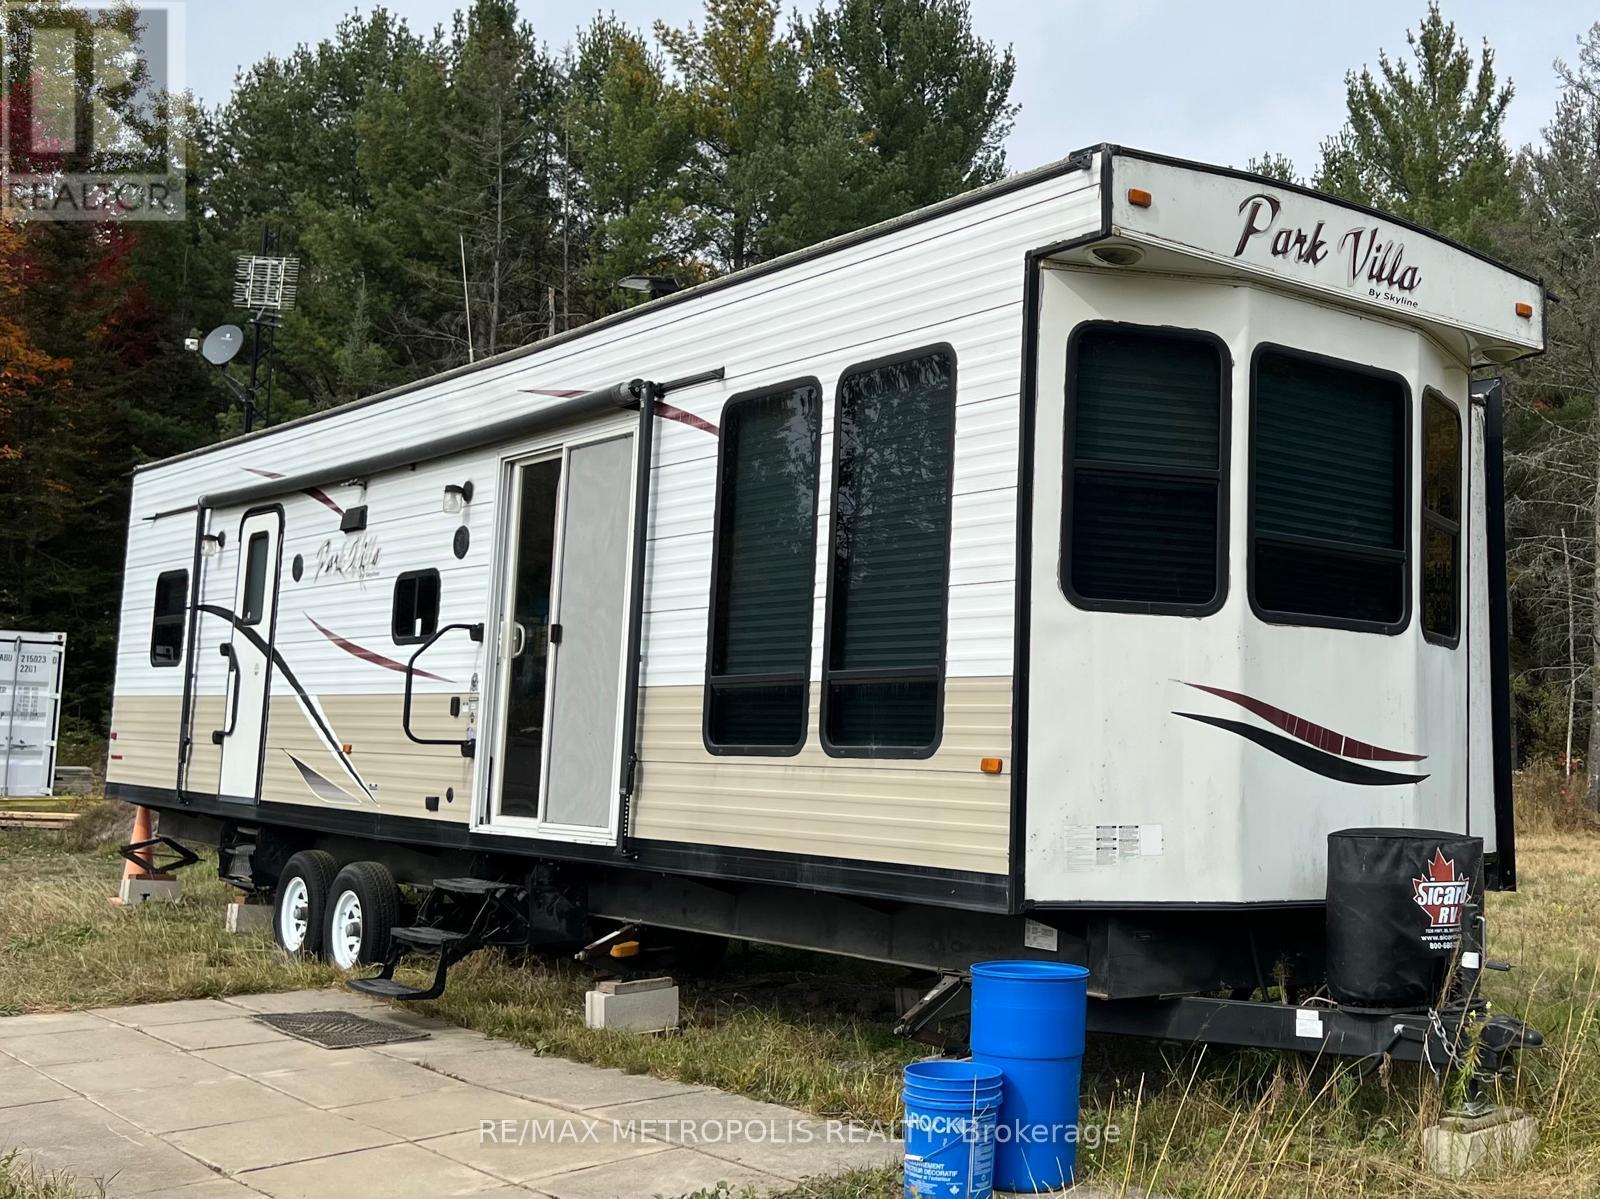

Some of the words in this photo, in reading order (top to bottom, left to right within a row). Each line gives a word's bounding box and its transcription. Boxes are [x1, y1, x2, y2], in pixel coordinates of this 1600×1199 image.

[1234, 193, 1329, 267] Park
[1337, 227, 1422, 292] Villa
[1368, 288, 1381, 299] By
[1383, 292, 1419, 308] Skyline
[1417, 878, 1469, 906] Sicard
[1438, 906, 1458, 923] RV
